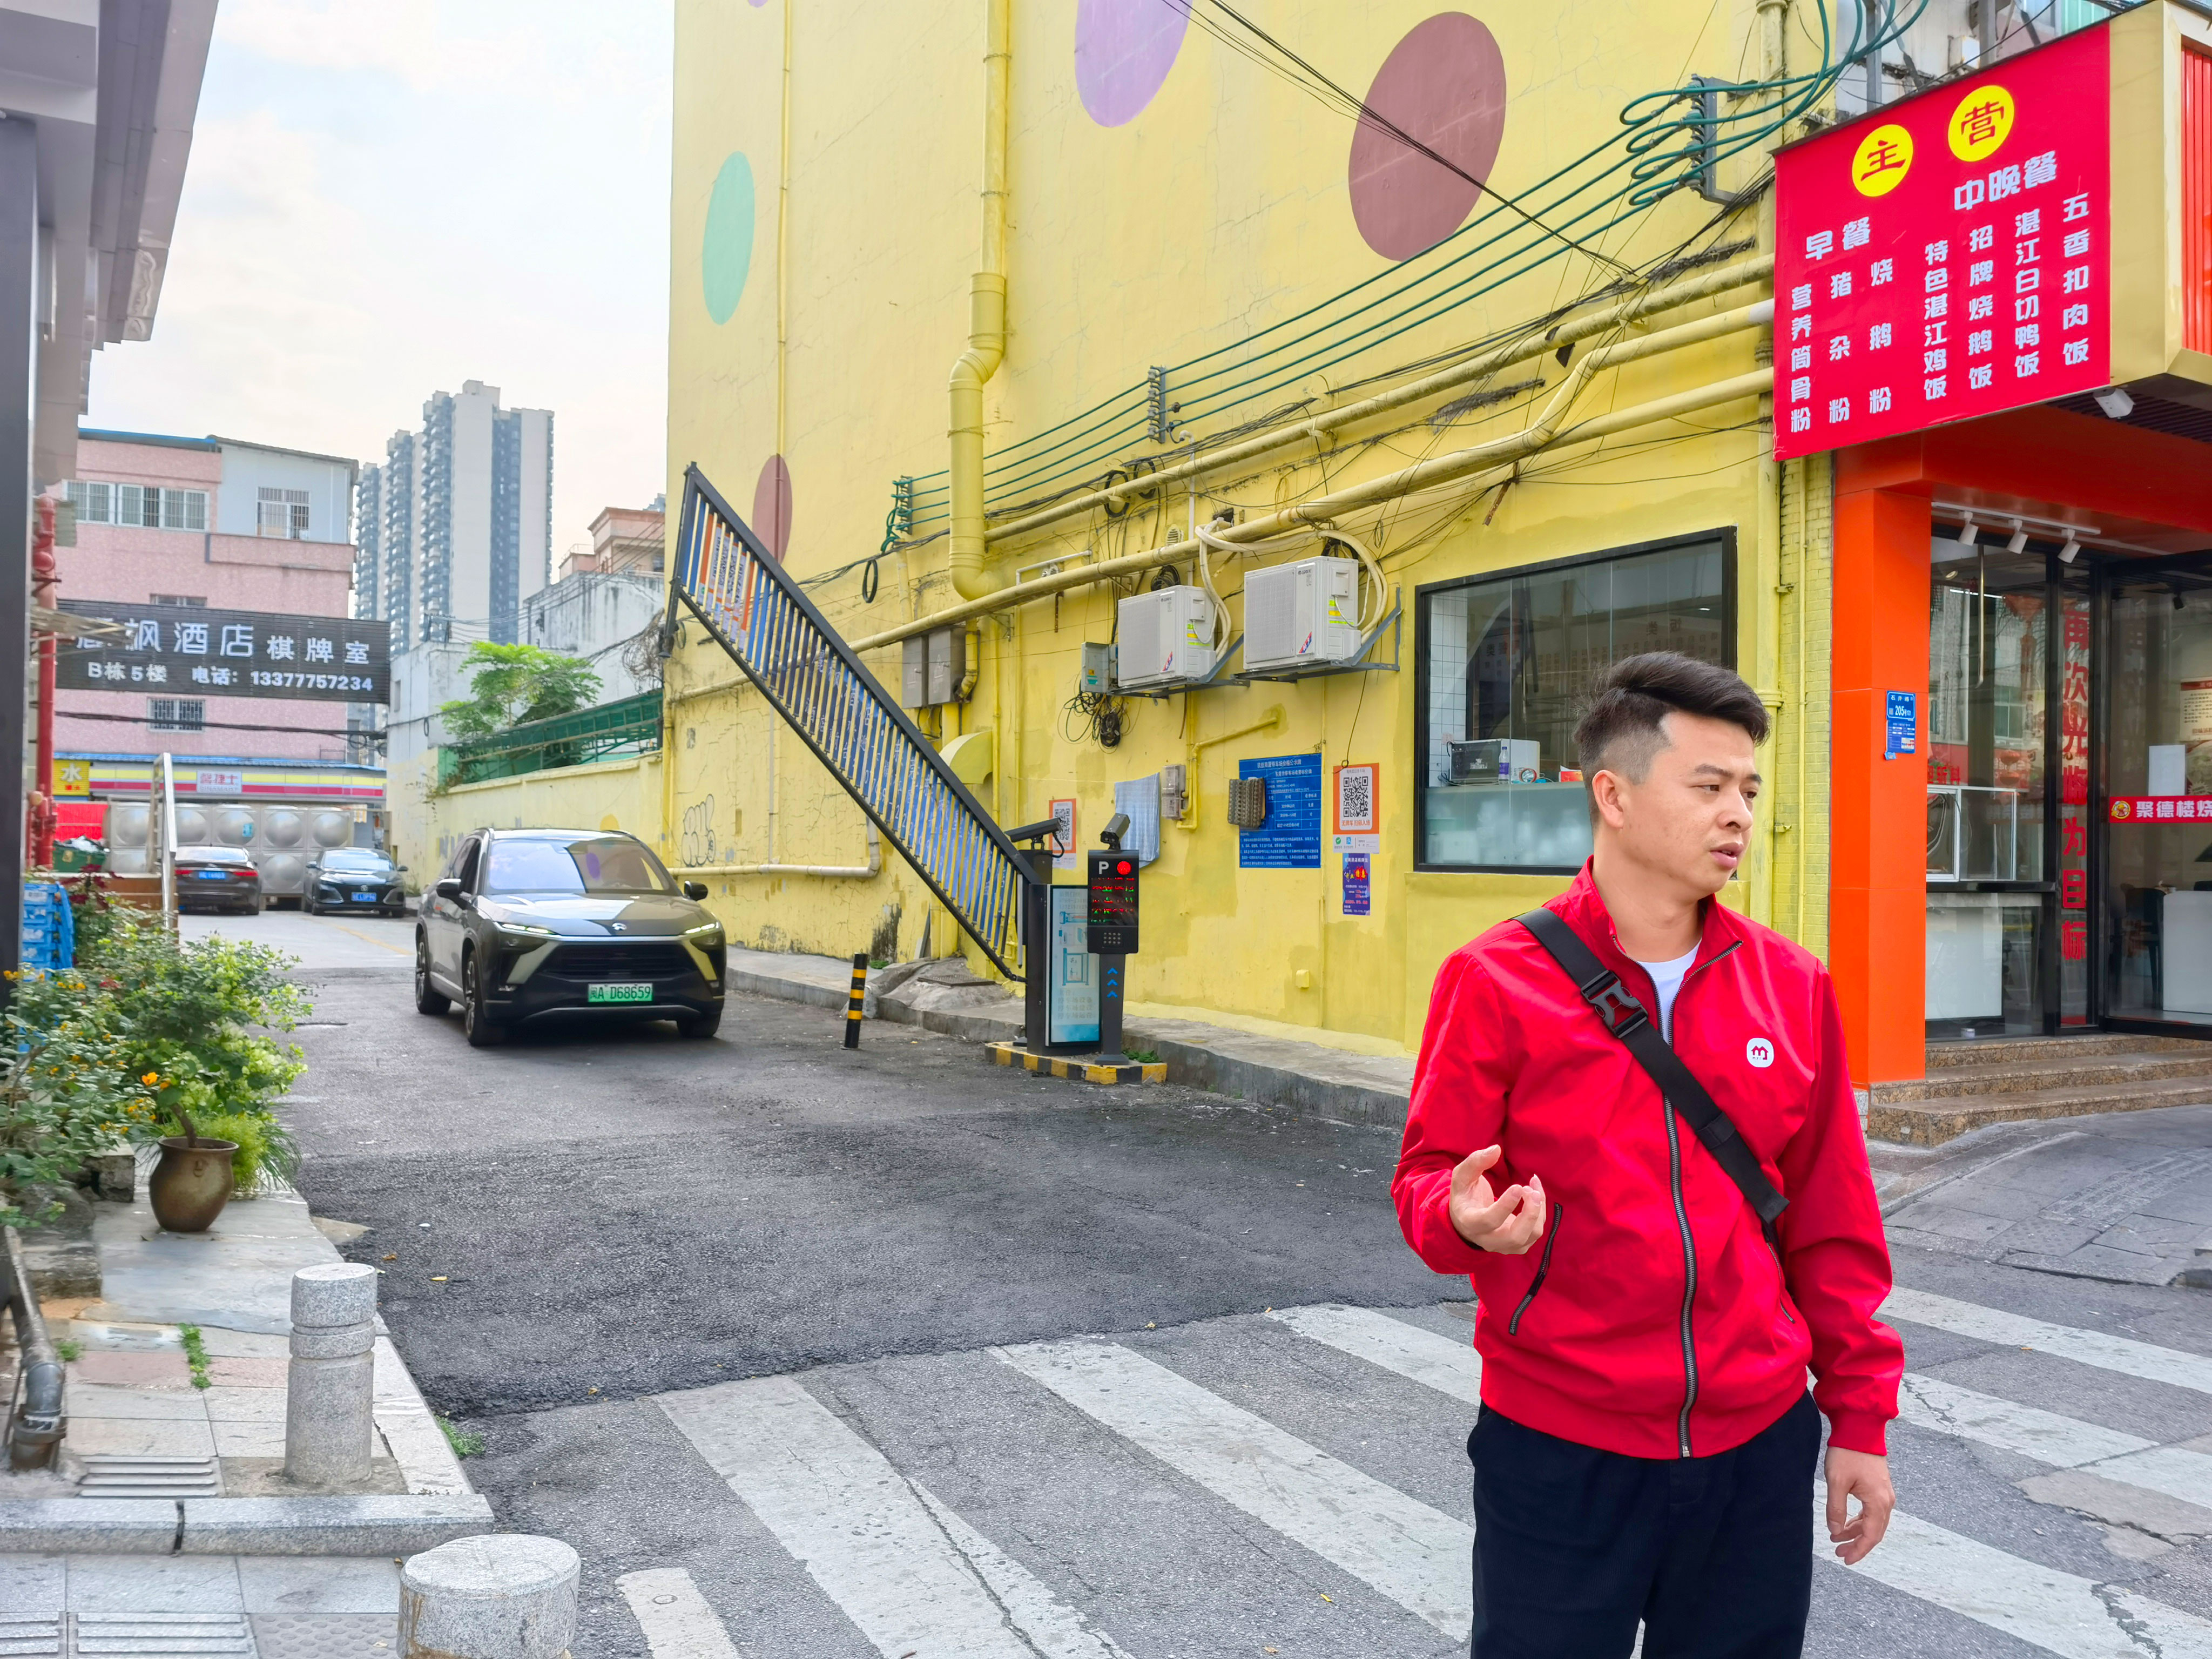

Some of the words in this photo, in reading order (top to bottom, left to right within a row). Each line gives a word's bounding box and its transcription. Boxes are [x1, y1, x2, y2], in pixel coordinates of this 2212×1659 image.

[1860, 100, 2005, 181] 主营
[1954, 151, 2057, 211] 中晚餐
[1805, 217, 1870, 261] 早餐
[2062, 192, 2089, 366] 五香扣肉饭
[1924, 240, 1948, 400] 特色湛江鸡饭
[1968, 225, 1993, 389] 招牌烧鹅饭
[2014, 208, 2041, 377] 湛江白切鸭饭
[1791, 283, 1812, 433] 营养筒骨粉
[1829, 271, 1852, 424] 猪杂粉
[1870, 258, 1893, 414] 烧鹅粉
[76, 617, 369, 665] 枫酒店棋牌室
[250, 671, 373, 691] 13377757234
[60, 763, 83, 782] 水
[2062, 611, 2089, 960] 再次光临为目标
[2136, 800, 2212, 818] 聚德楼烧
[1098, 861, 1109, 875] P
[610, 986, 651, 999] D68659
